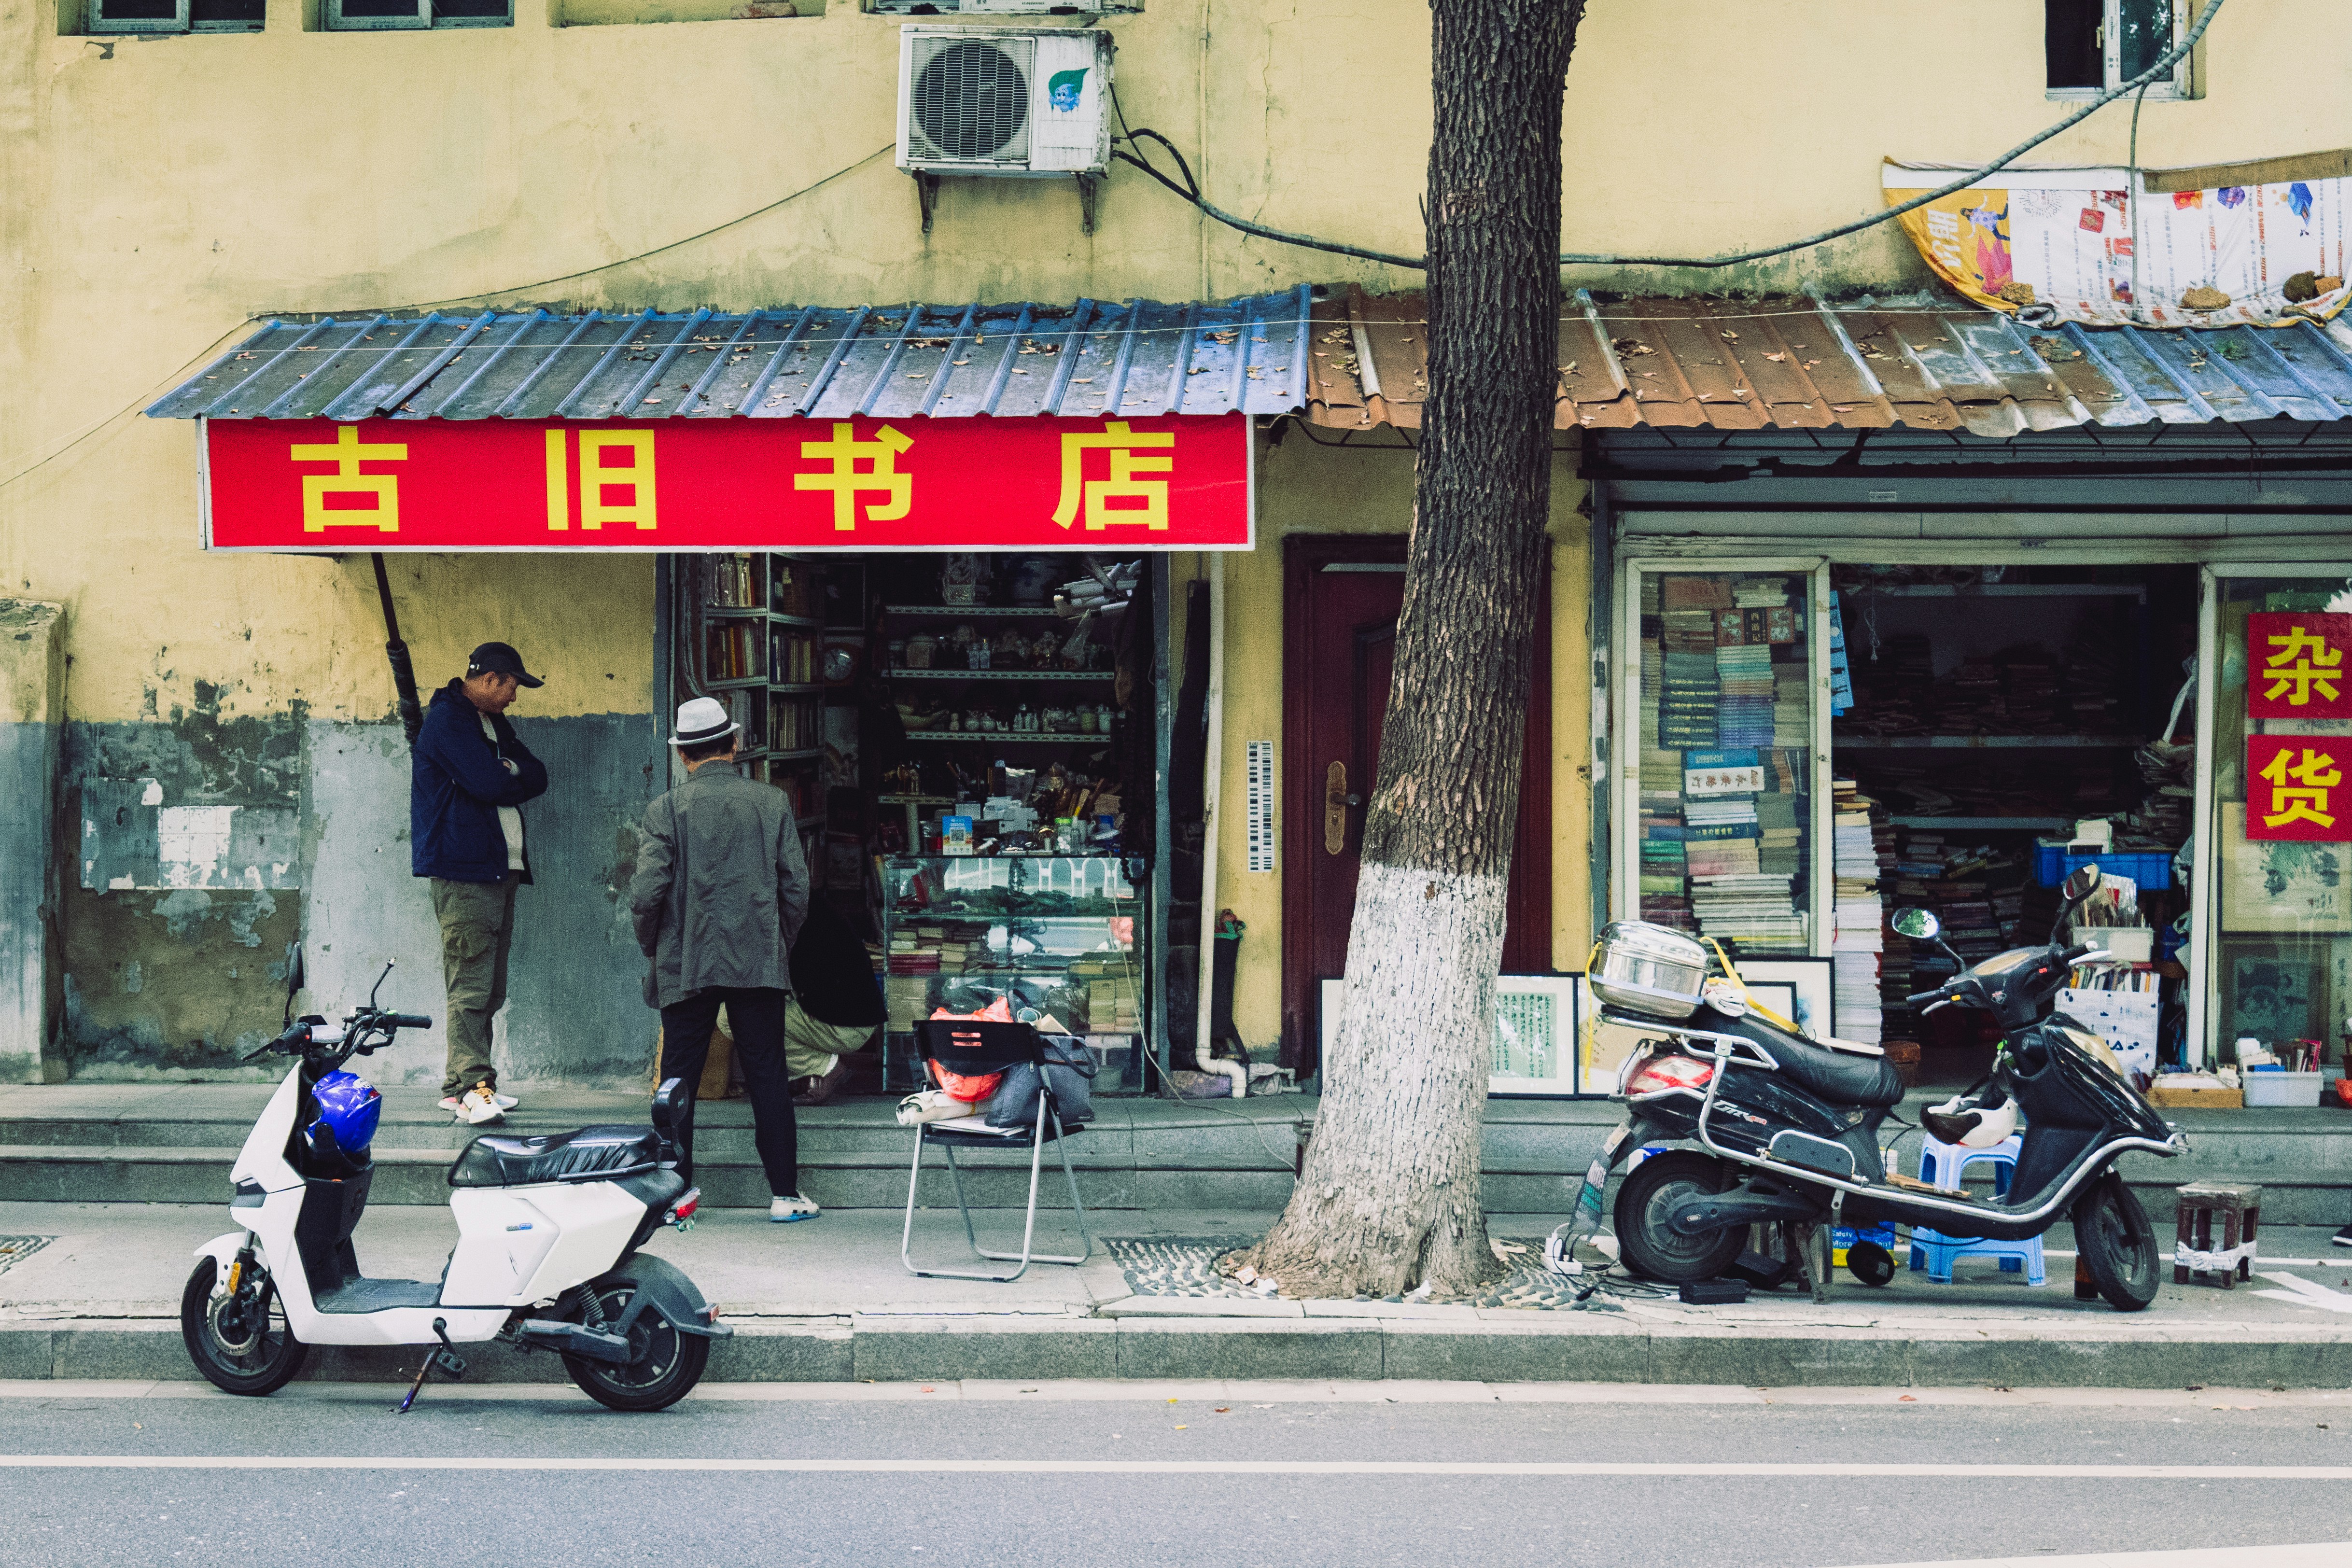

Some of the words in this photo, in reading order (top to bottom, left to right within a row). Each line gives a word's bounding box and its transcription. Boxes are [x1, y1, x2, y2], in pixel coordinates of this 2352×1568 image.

[291, 422, 1174, 532] 古旧书店
[2259, 626, 2342, 828] 杂货
